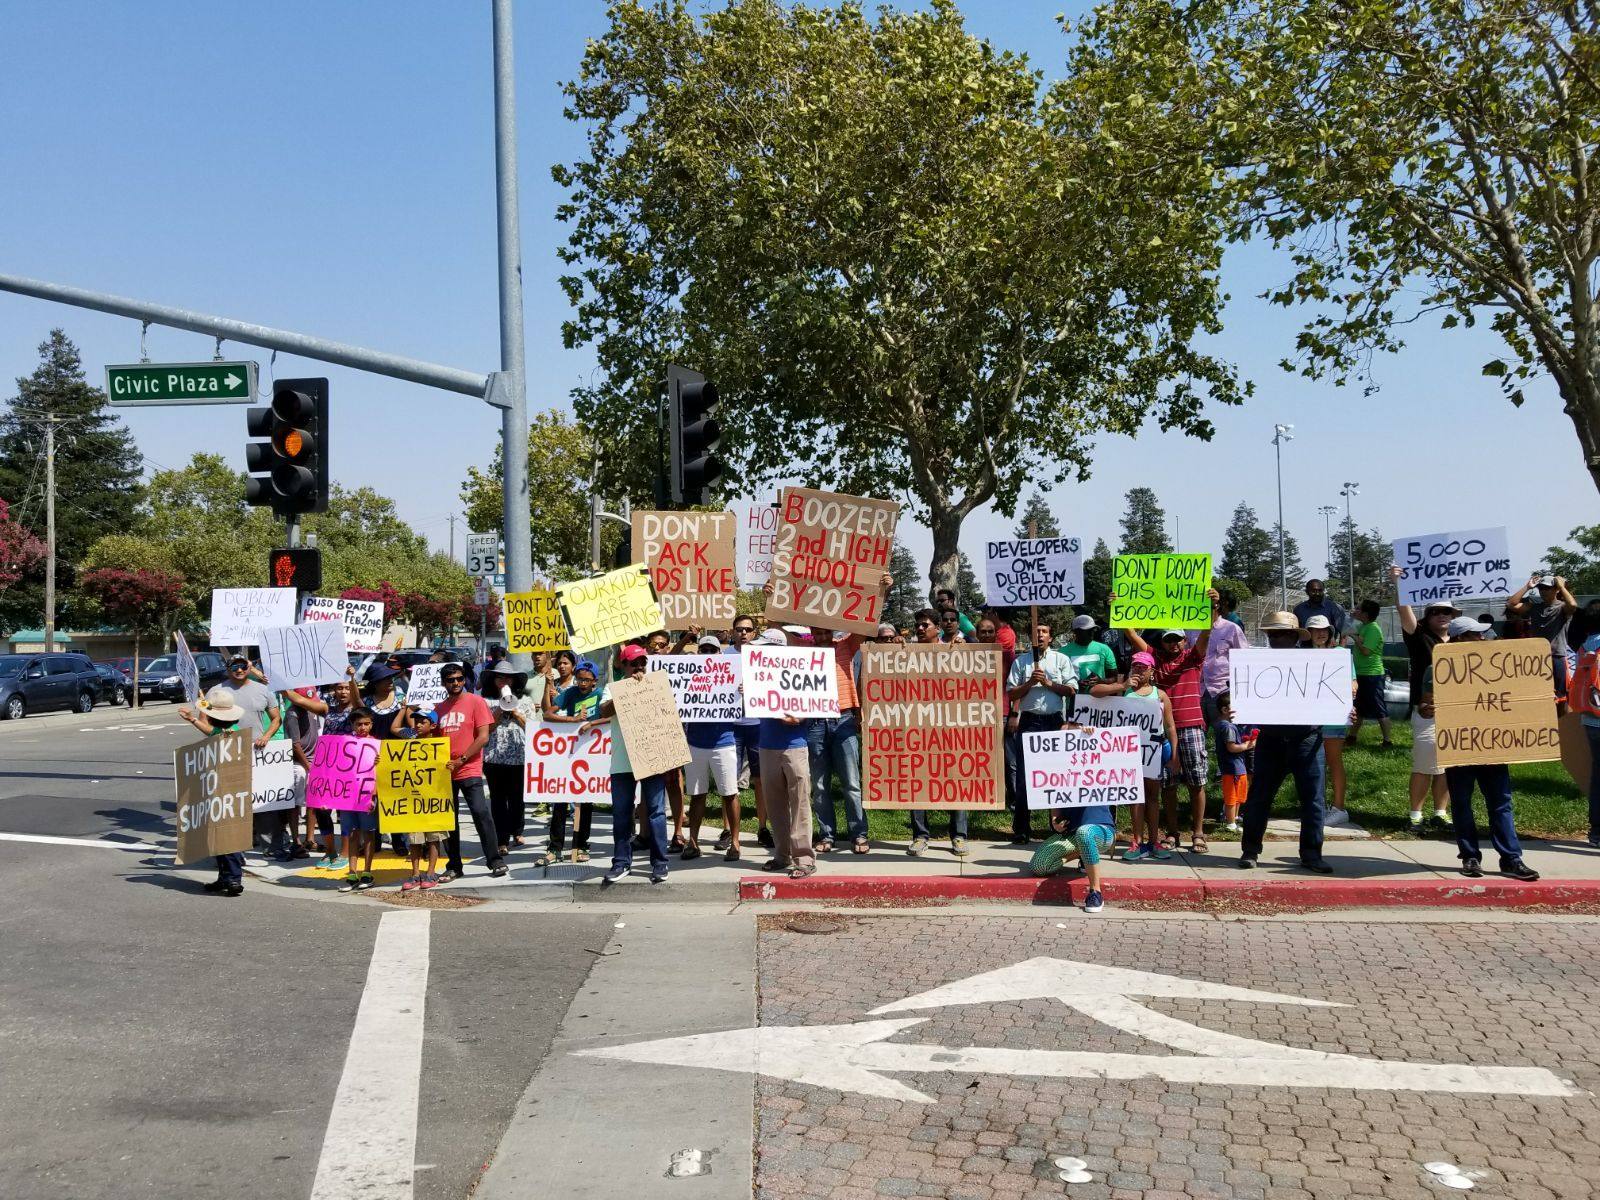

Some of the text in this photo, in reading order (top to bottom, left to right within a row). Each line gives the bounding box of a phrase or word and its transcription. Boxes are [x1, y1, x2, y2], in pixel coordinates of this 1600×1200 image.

[114, 374, 218, 394] Civic Plaza
[749, 507, 779, 531] HON
[785, 490, 897, 537] BOOZER!
[643, 515, 726, 540] DON'T
[470, 537, 496, 545] SPEED
[471, 547, 493, 555] LIMIT
[778, 524, 889, 567] 2nd HIGH
[470, 556, 496, 572] 35
[643, 541, 709, 566] PACK
[1407, 540, 1486, 567] 5,000
[747, 560, 773, 574] RESO
[773, 550, 864, 590] SCHOOL
[1011, 557, 1047, 573] OWE
[1166, 556, 1208, 582] DOOM
[1400, 559, 1511, 580] STUDENT DHS
[569, 571, 648, 605] OUR KIDS
[686, 567, 732, 592] LIKE
[995, 569, 1067, 588] DUBLIN
[224, 590, 283, 606] DUBLIN
[771, 578, 877, 623] BY 2021
[1117, 582, 1206, 601] DHS WITH
[1409, 585, 1474, 602] TRAFFIC
[232, 606, 272, 617] NEEDS
[306, 598, 376, 613] DUSD BOARD
[546, 597, 559, 611] DO
[597, 593, 630, 618] ARE
[661, 593, 736, 619] RDINES
[1112, 605, 1210, 622] 5000+ KIDS
[344, 626, 376, 636] TMENT
[513, 614, 566, 632] DHS WI
[263, 625, 342, 679] HONK
[749, 651, 826, 671] MEASURE H
[867, 650, 997, 674] MEGAN ROUSE
[415, 667, 431, 676] OUR
[703, 658, 731, 674] SAVE
[1434, 652, 1553, 684] OUR SCHOOLS
[688, 684, 713, 693] AWAY
[779, 670, 827, 691] SCAM
[866, 678, 997, 702] CUNNINGHAM
[1234, 661, 1346, 704] HONK
[426, 689, 448, 701] SCHO
[684, 693, 735, 704] DOLLARS
[767, 690, 840, 713] DUBLINERS
[1475, 692, 1512, 712] ARE
[440, 711, 465, 727] GAP
[678, 707, 742, 719] ONTRACTORS
[868, 702, 996, 727] AMY MILLER
[1089, 708, 1113, 728] HIGH
[532, 728, 611, 758] GOT 2n
[868, 727, 994, 752] JOE GIANNINI
[1029, 731, 1139, 754] USE BIDS SAVE
[1437, 726, 1560, 751] OVERCROWDED
[185, 736, 242, 776] HONK!
[252, 749, 293, 767] HOOLS
[386, 741, 445, 762] WEST
[1140, 744, 1158, 767] TY
[869, 752, 991, 778] STEP UP OR
[200, 769, 218, 798] TO
[310, 777, 352, 798] GRADE
[391, 767, 437, 788] EAST
[527, 759, 612, 795] HIGH SCHO
[1032, 768, 1137, 788] DON'T SCAM
[869, 779, 995, 805] STEP DOWN!
[1044, 787, 1139, 805] TAX PAYERS
[180, 791, 250, 833] SUPPORT
[413, 797, 455, 814] DUBLIN
